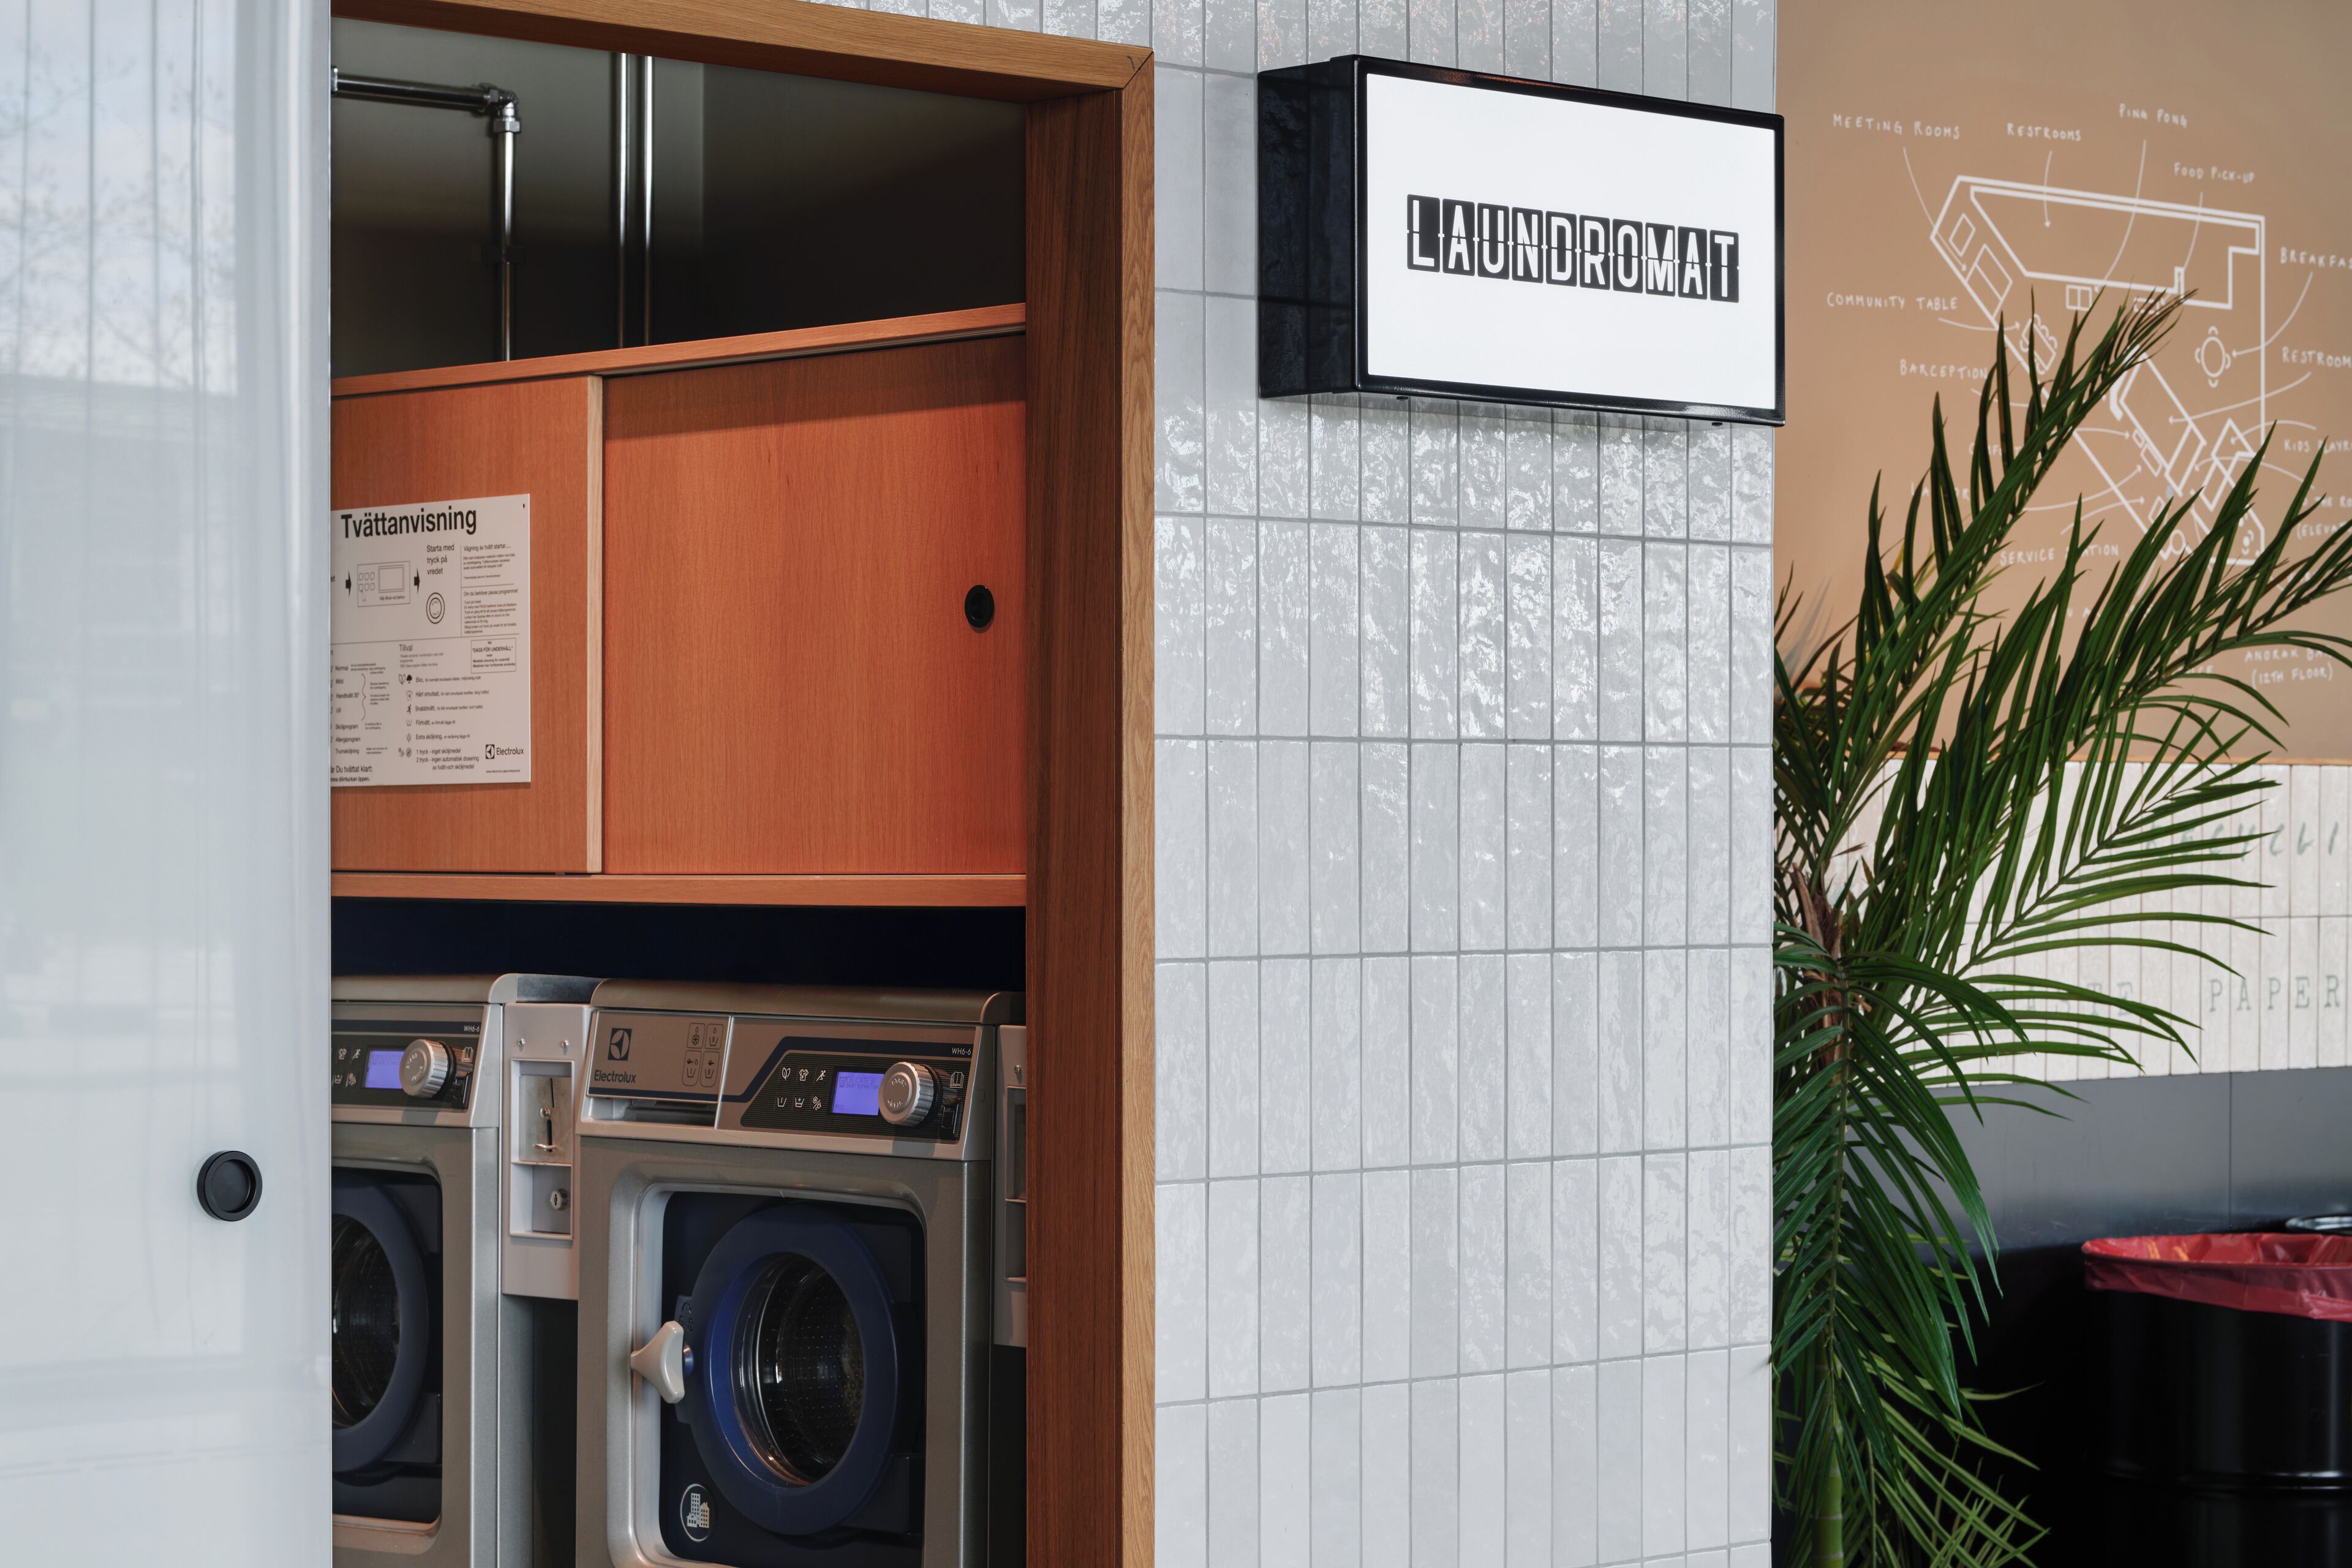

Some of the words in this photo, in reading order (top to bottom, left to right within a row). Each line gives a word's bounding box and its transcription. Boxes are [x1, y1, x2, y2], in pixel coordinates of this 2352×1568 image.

[1833, 113, 1902, 135] MEETING
[1914, 121, 1960, 140] ROOMS
[2007, 123, 2081, 141] RESTROOMS
[2174, 162, 2203, 179] FOOD
[1412, 199, 1735, 298] LAUNDROMAT
[1826, 292, 1905, 308] COMMUNITY
[1917, 296, 1958, 311] TABLE
[1900, 358, 1988, 380] BARCEPTION
[2284, 439, 2310, 453] KIDS
[341, 505, 477, 538] Tvättanvisning
[1999, 548, 2055, 567] SERVICE
[2209, 975, 2340, 1012] PAPER
[951, 1047, 972, 1056] WH6-6
[594, 1069, 636, 1084] Electrolux
